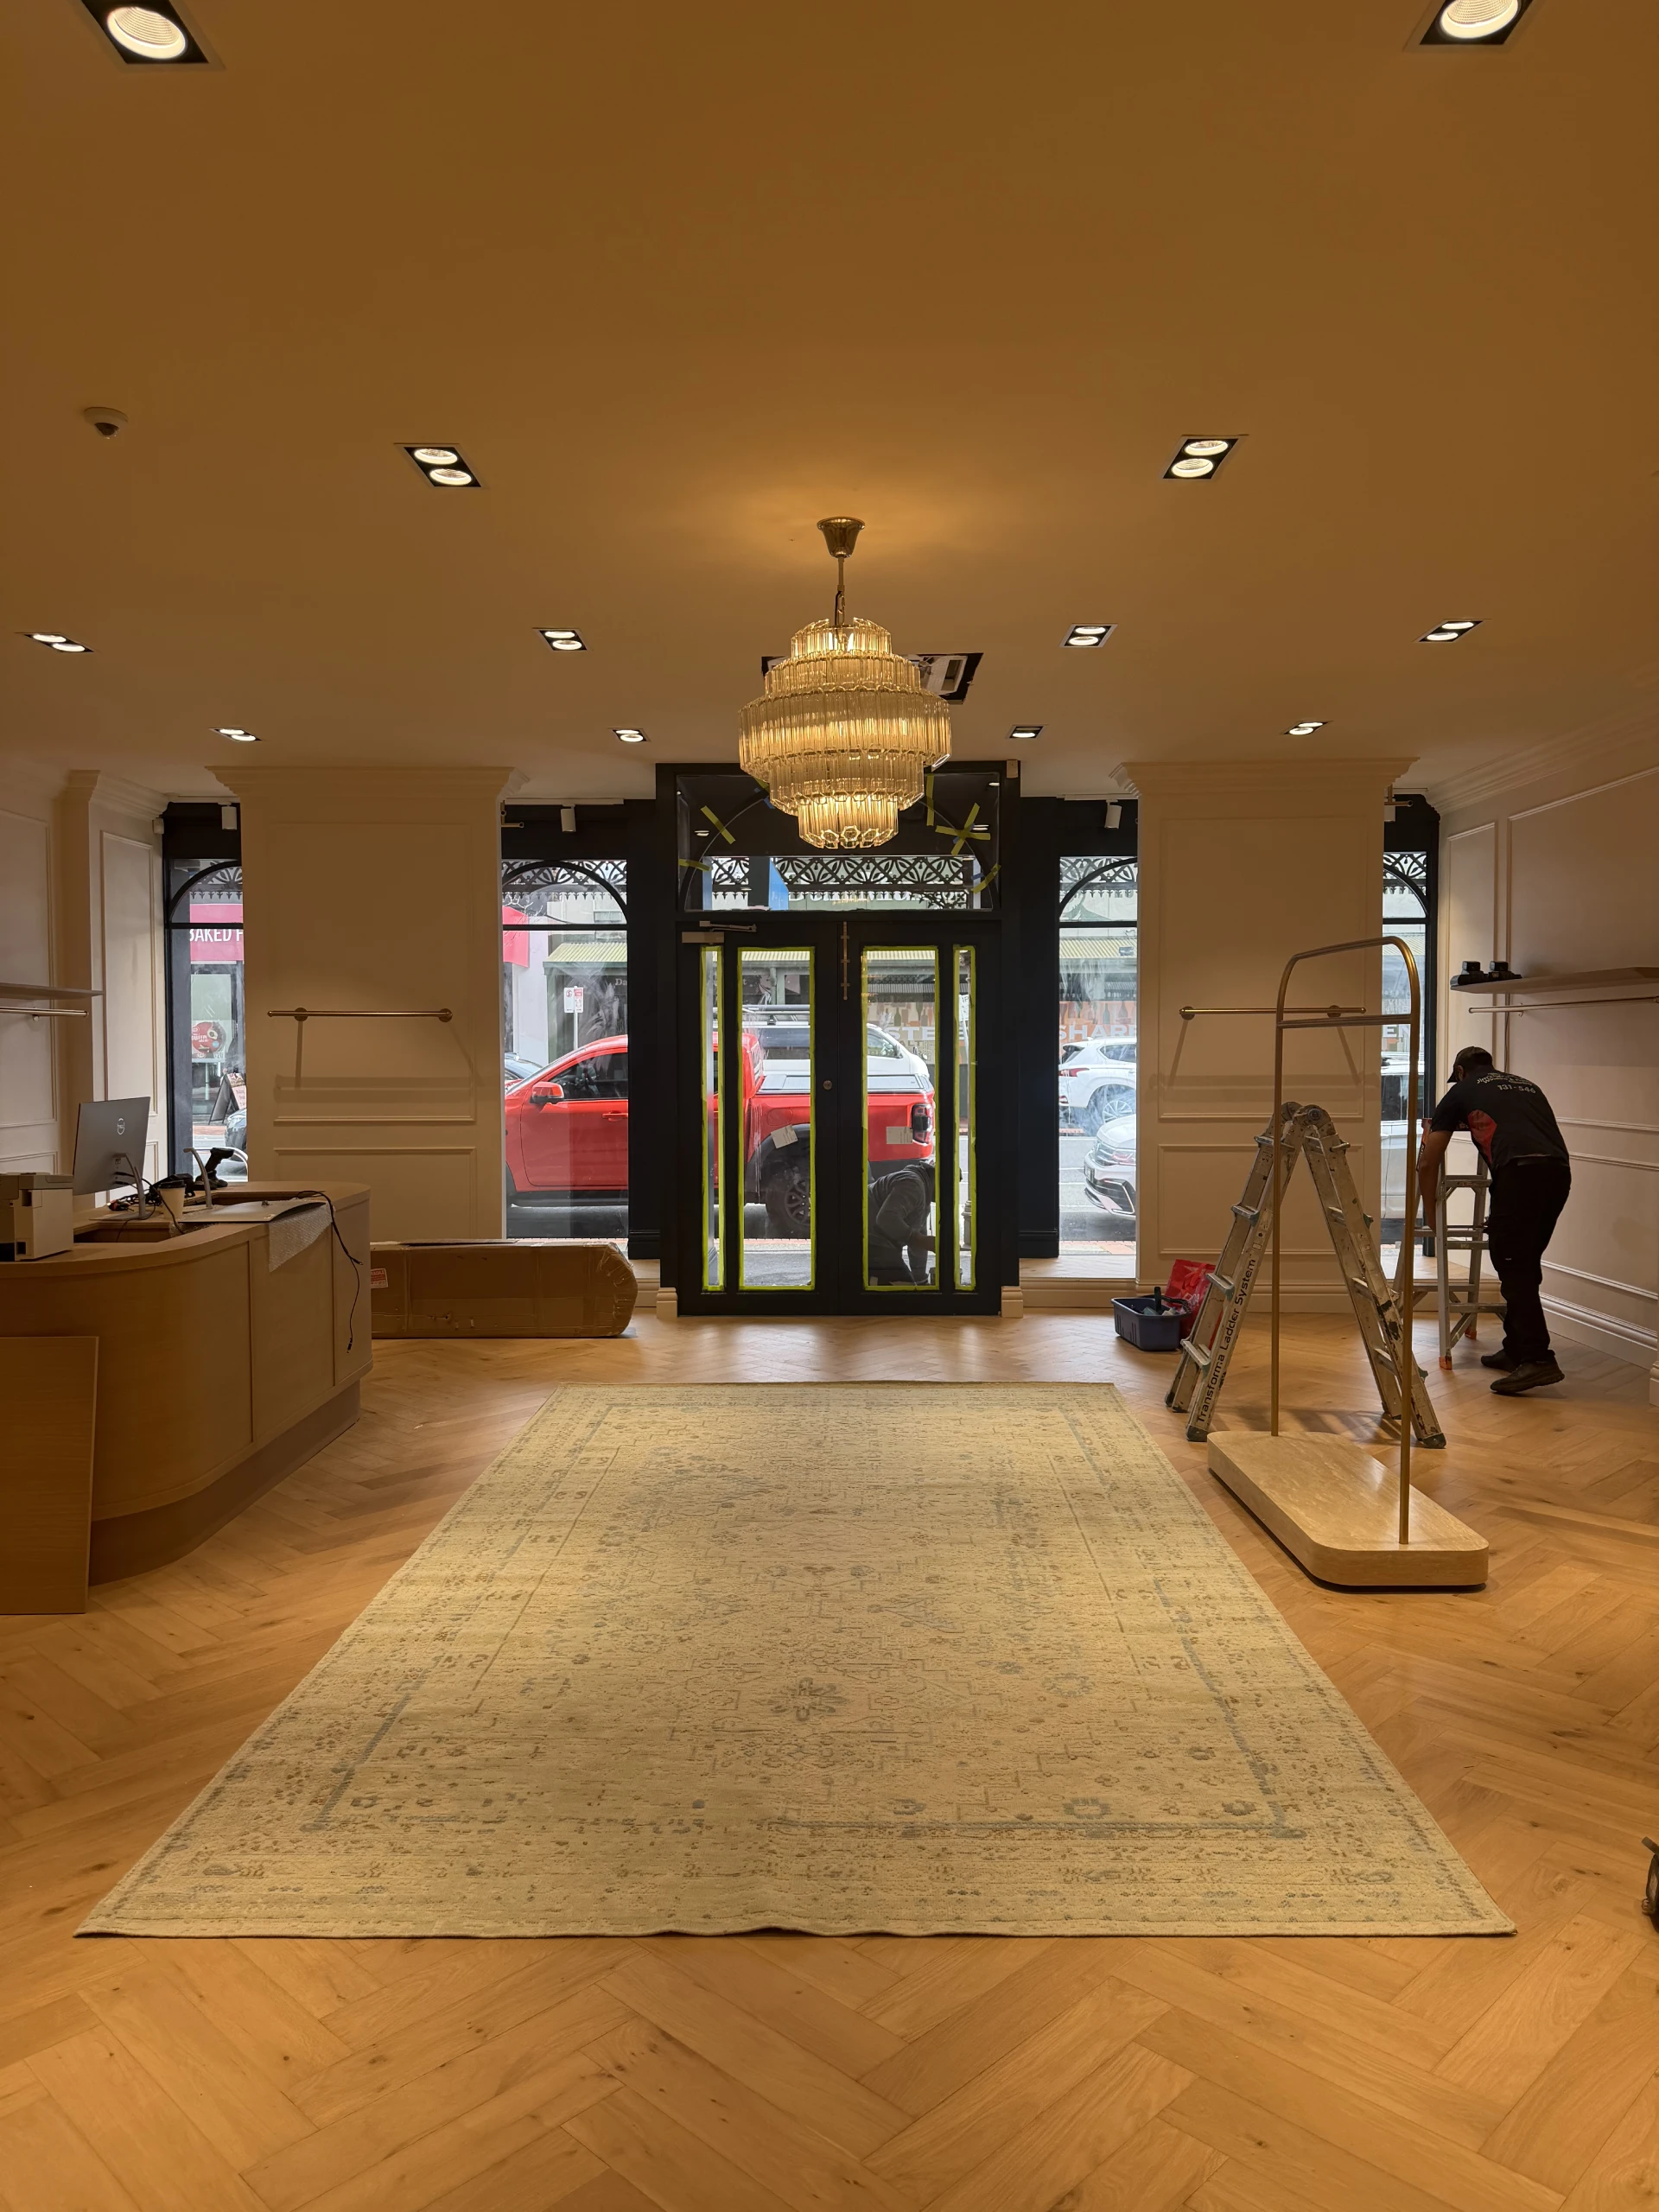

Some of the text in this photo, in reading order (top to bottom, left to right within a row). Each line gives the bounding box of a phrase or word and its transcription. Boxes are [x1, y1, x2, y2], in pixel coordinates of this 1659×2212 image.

[1197, 1259, 1256, 1422] Transforma Ladder System
